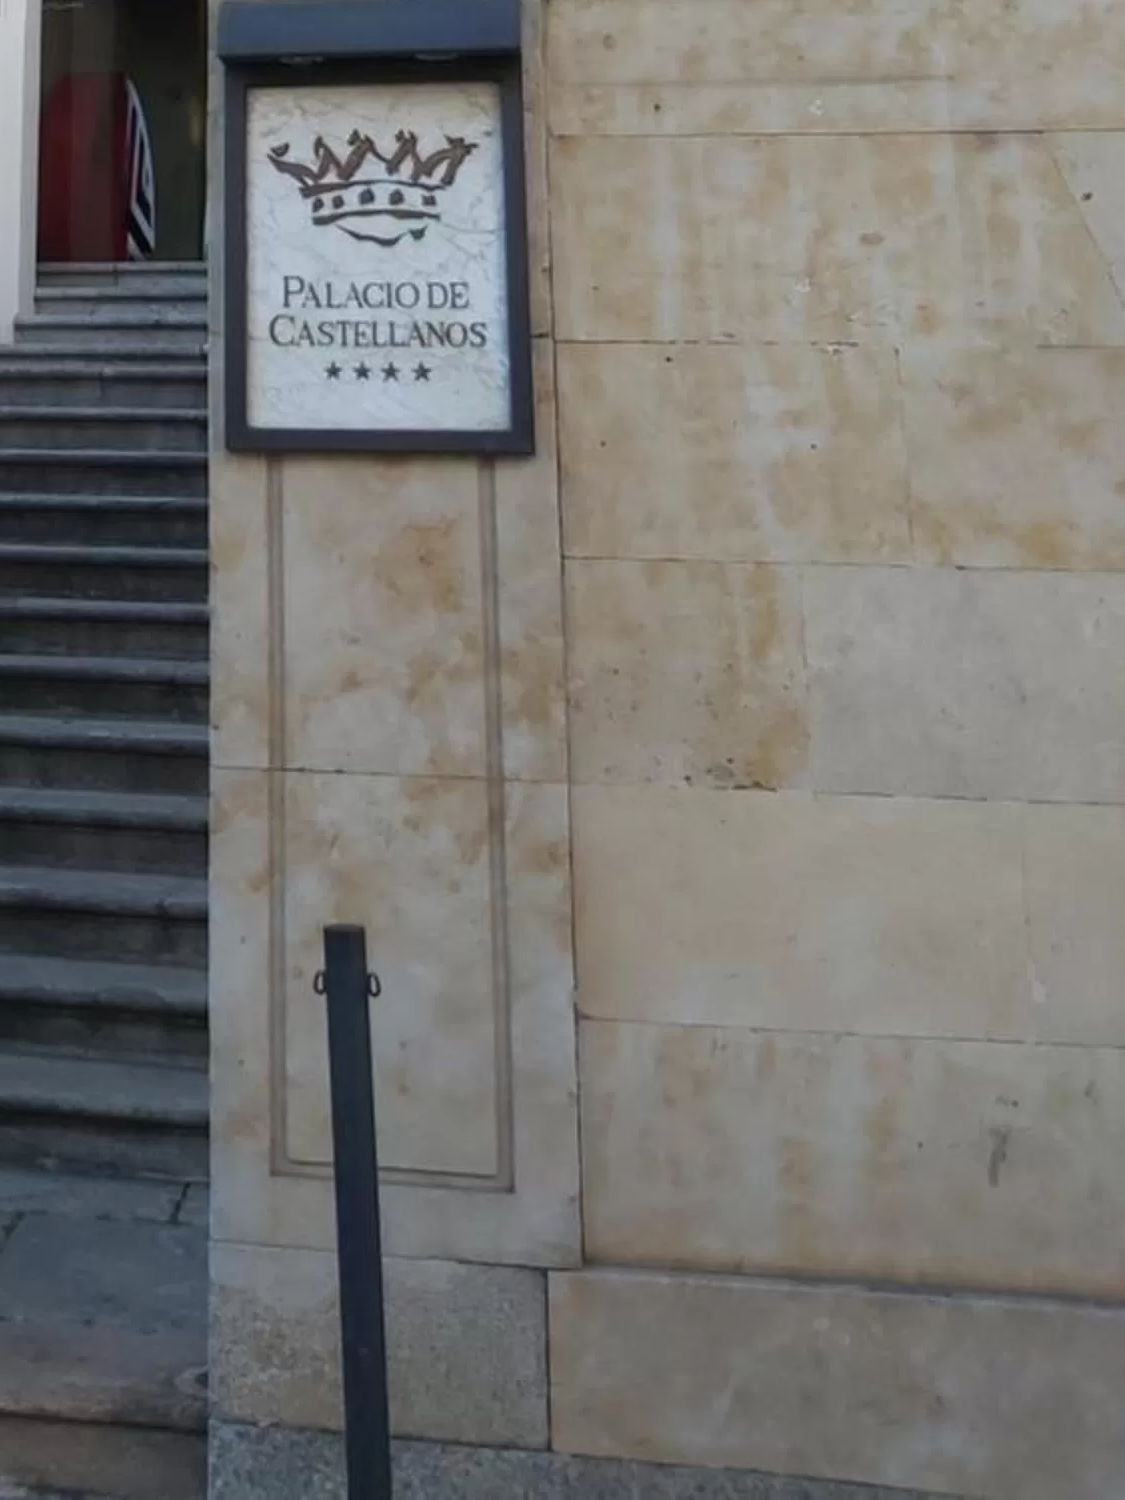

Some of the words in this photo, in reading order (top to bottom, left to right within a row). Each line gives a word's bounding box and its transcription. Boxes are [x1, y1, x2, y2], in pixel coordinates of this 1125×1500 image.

[282, 275, 421, 310] PALACIO
[426, 281, 470, 310] DE
[268, 314, 488, 348] CASTELLANOS
